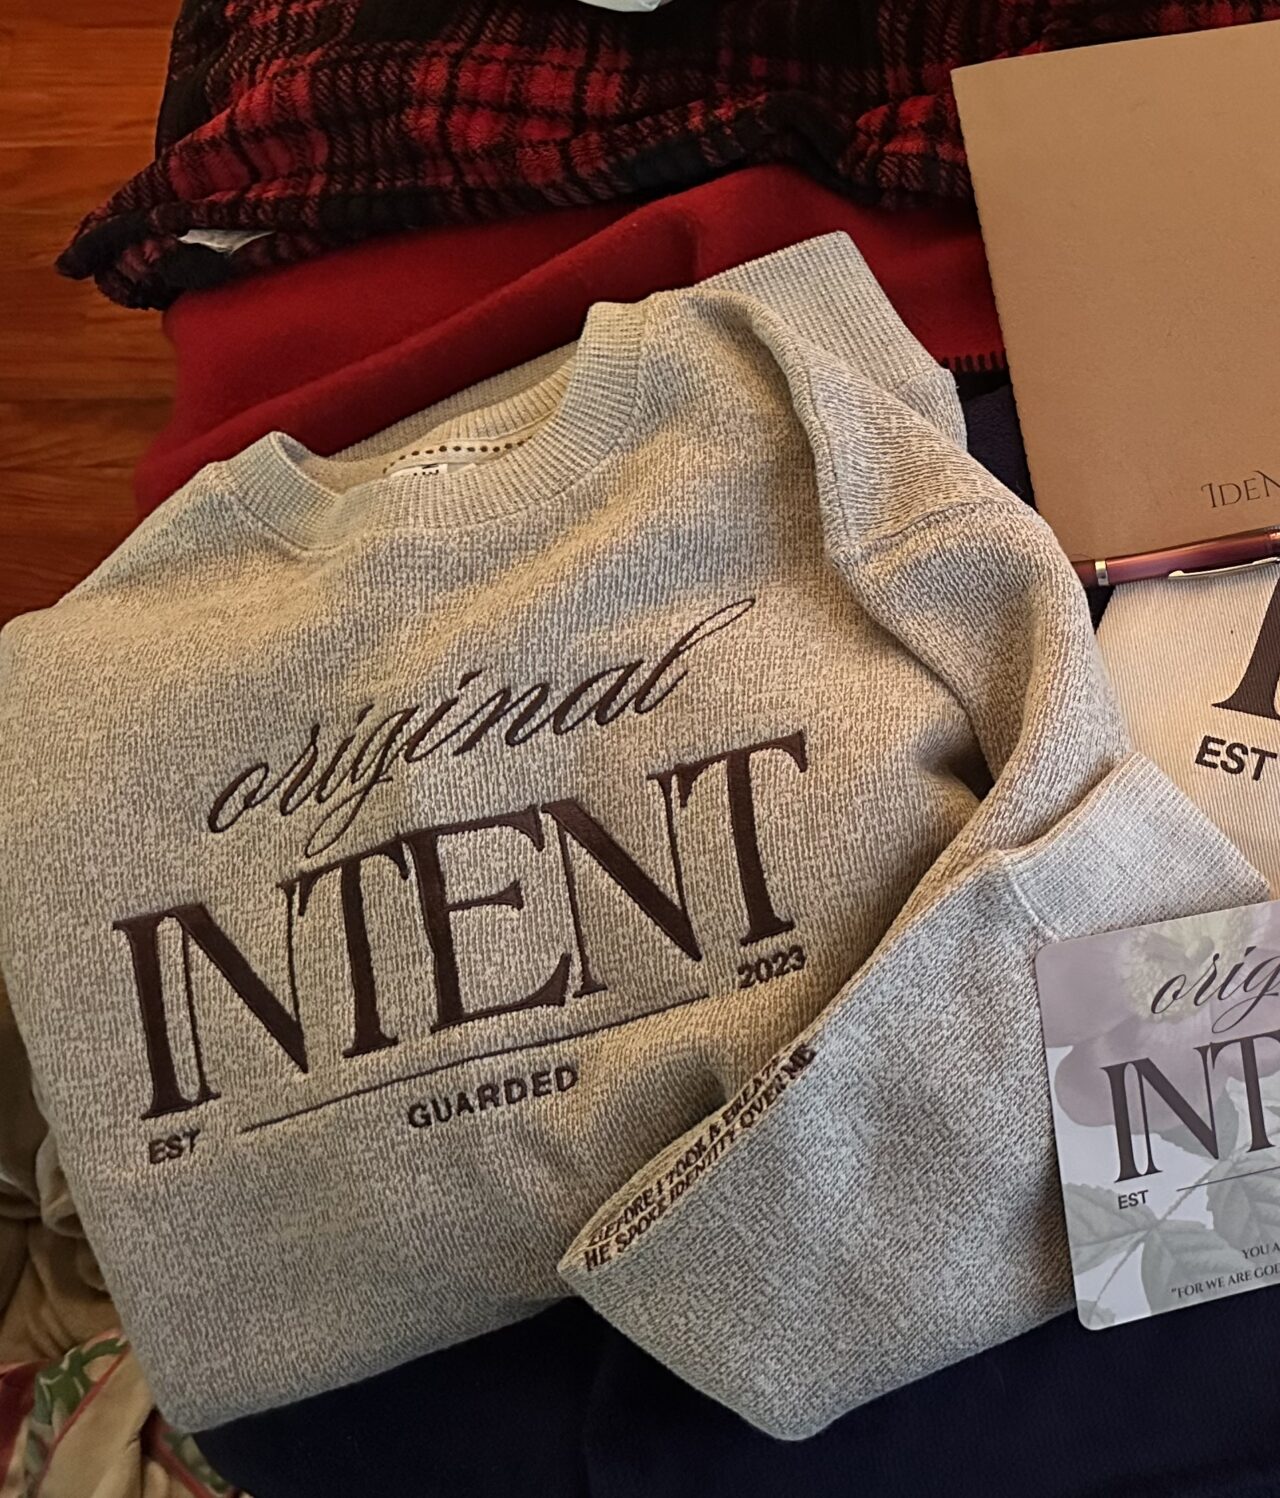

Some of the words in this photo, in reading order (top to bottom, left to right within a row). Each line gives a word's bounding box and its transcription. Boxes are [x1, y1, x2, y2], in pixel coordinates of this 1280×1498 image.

[206, 598, 757, 860] original
[1195, 735, 1277, 781] EST
[112, 729, 808, 1121] INTENT
[737, 944, 807, 990] 2023
[408, 1066, 580, 1130] GUARDED
[148, 1129, 201, 1165] EST
[583, 1248, 612, 1272] HE
[615, 1198, 667, 1253] SPOKE
[669, 1129, 737, 1204] IDENTITY
[740, 1075, 787, 1129] OVER
[1117, 1189, 1149, 1211] EST
[1241, 1243, 1271, 1261] YOU
[1204, 1276, 1226, 1292] WE
[1227, 1270, 1253, 1287] ARE
